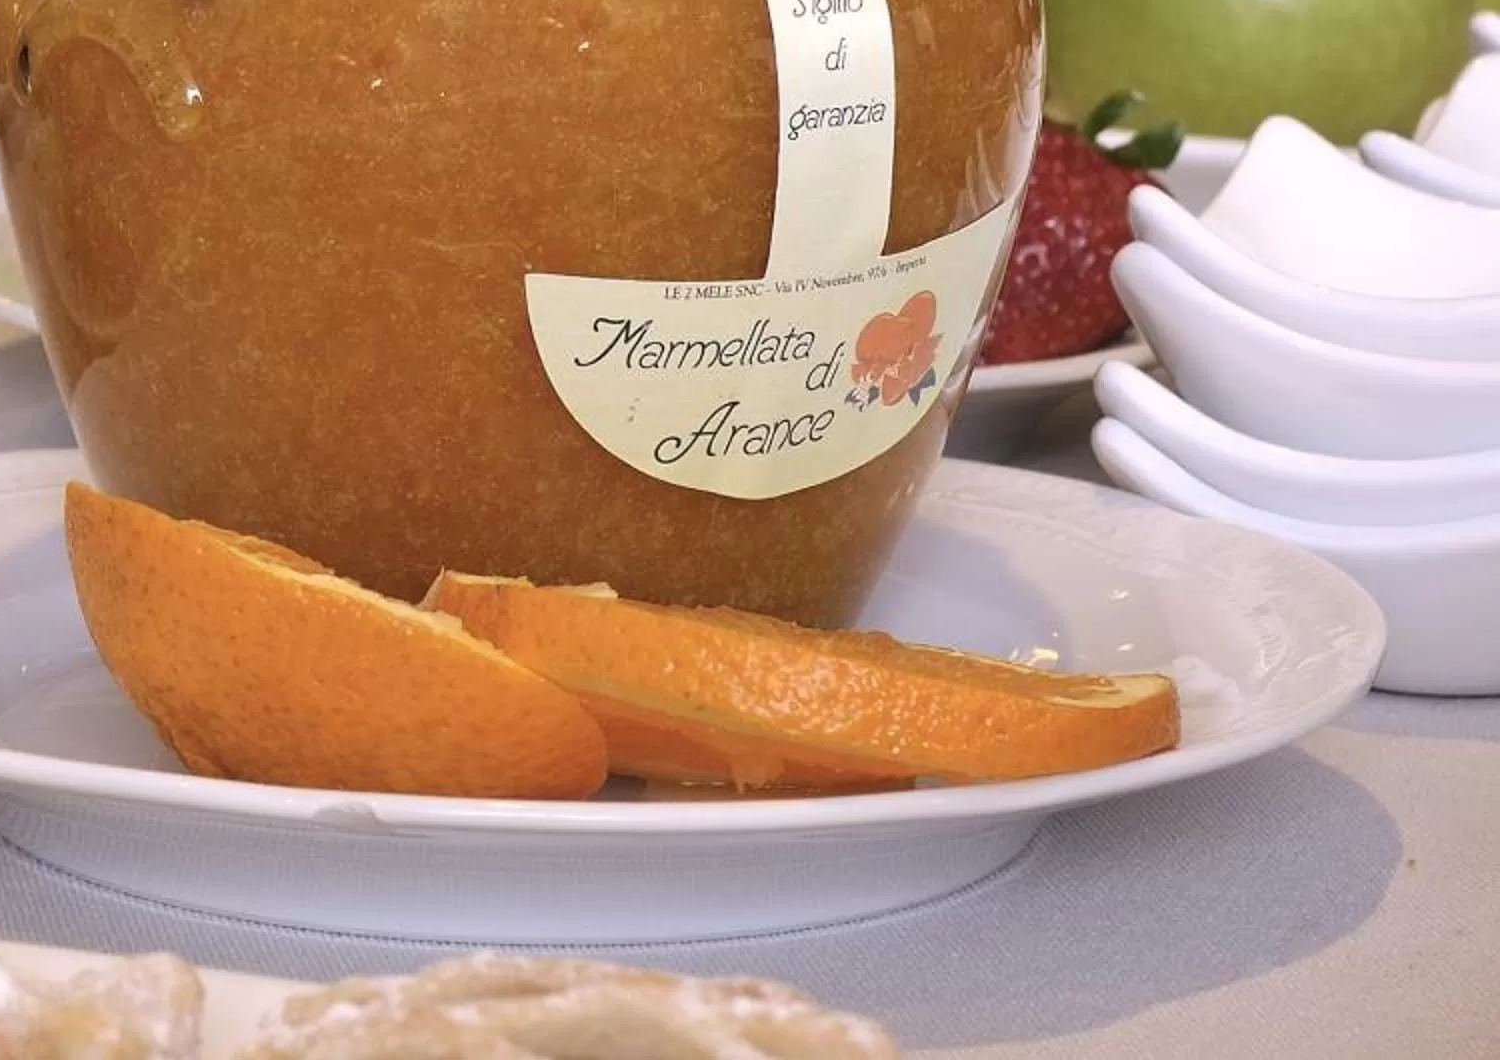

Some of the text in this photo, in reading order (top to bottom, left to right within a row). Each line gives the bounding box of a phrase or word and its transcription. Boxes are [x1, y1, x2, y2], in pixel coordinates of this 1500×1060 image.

[825, 37, 848, 71] di
[787, 98, 887, 141] garanzia
[664, 286, 681, 299] LE
[683, 287, 693, 299] 2
[696, 285, 733, 298] MELE
[735, 283, 764, 297] SNC
[775, 281, 792, 292] Via
[574, 317, 816, 371] Marmellata
[805, 339, 846, 391] di
[654, 401, 836, 464] Arance
